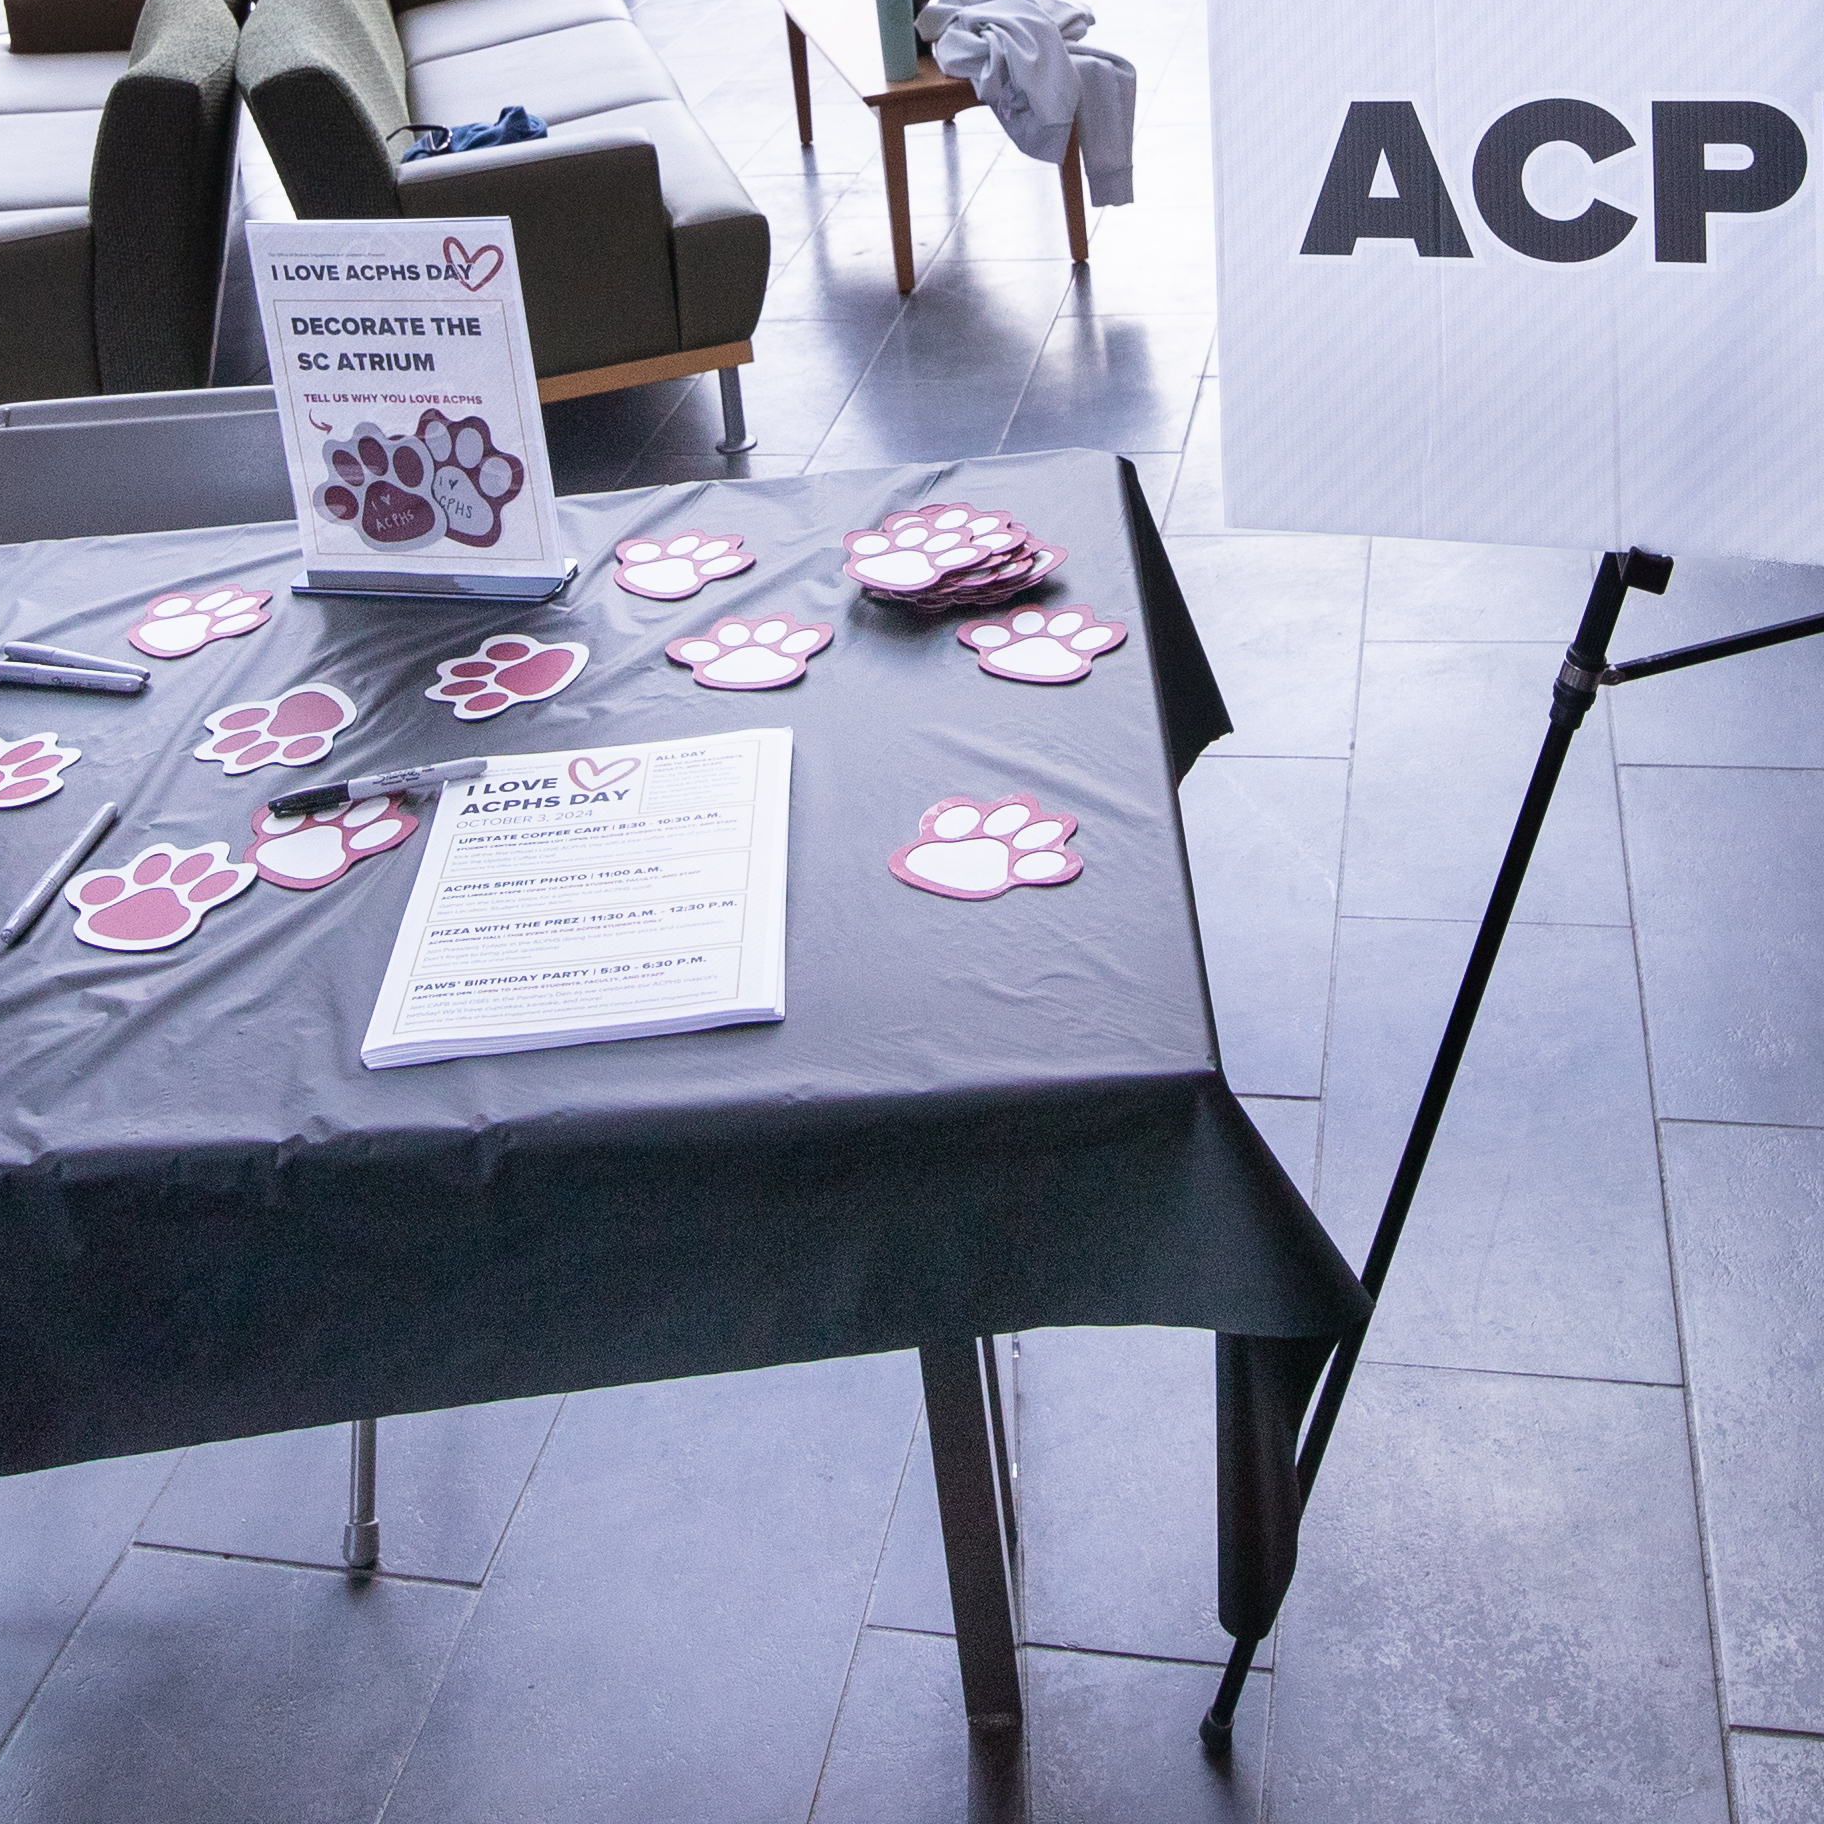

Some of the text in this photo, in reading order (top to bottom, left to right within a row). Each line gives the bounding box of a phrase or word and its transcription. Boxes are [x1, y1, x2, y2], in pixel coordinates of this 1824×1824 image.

[271, 264, 473, 281] I LOVE ACPHS DAY
[291, 317, 482, 336] DECORATE THE
[297, 352, 436, 371] SC ATRIUM
[304, 394, 483, 405] TELL US WHY YOU LOVE ACPHS
[438, 495, 474, 520] CPHS
[375, 509, 415, 532] ACPHS
[654, 750, 707, 761] ALL DAY
[466, 778, 558, 797] I LOVE
[460, 789, 631, 816] ACPHS DAY
[456, 809, 593, 829] OCTOBER 3, 2024
[458, 812, 722, 844] UPSTATE COFFEE CART 8:30 10:30 A.M.
[443, 866, 663, 892] ACPHS SPIRIT PHOTO 11:00 A.M.
[430, 900, 738, 937] PIZZA WITH THE PREZ 11:30 A.M. 12:30 P.M.
[414, 956, 707, 992] PAWS' BIRTHDAY PARTY 5:30 6:30 P.M.
